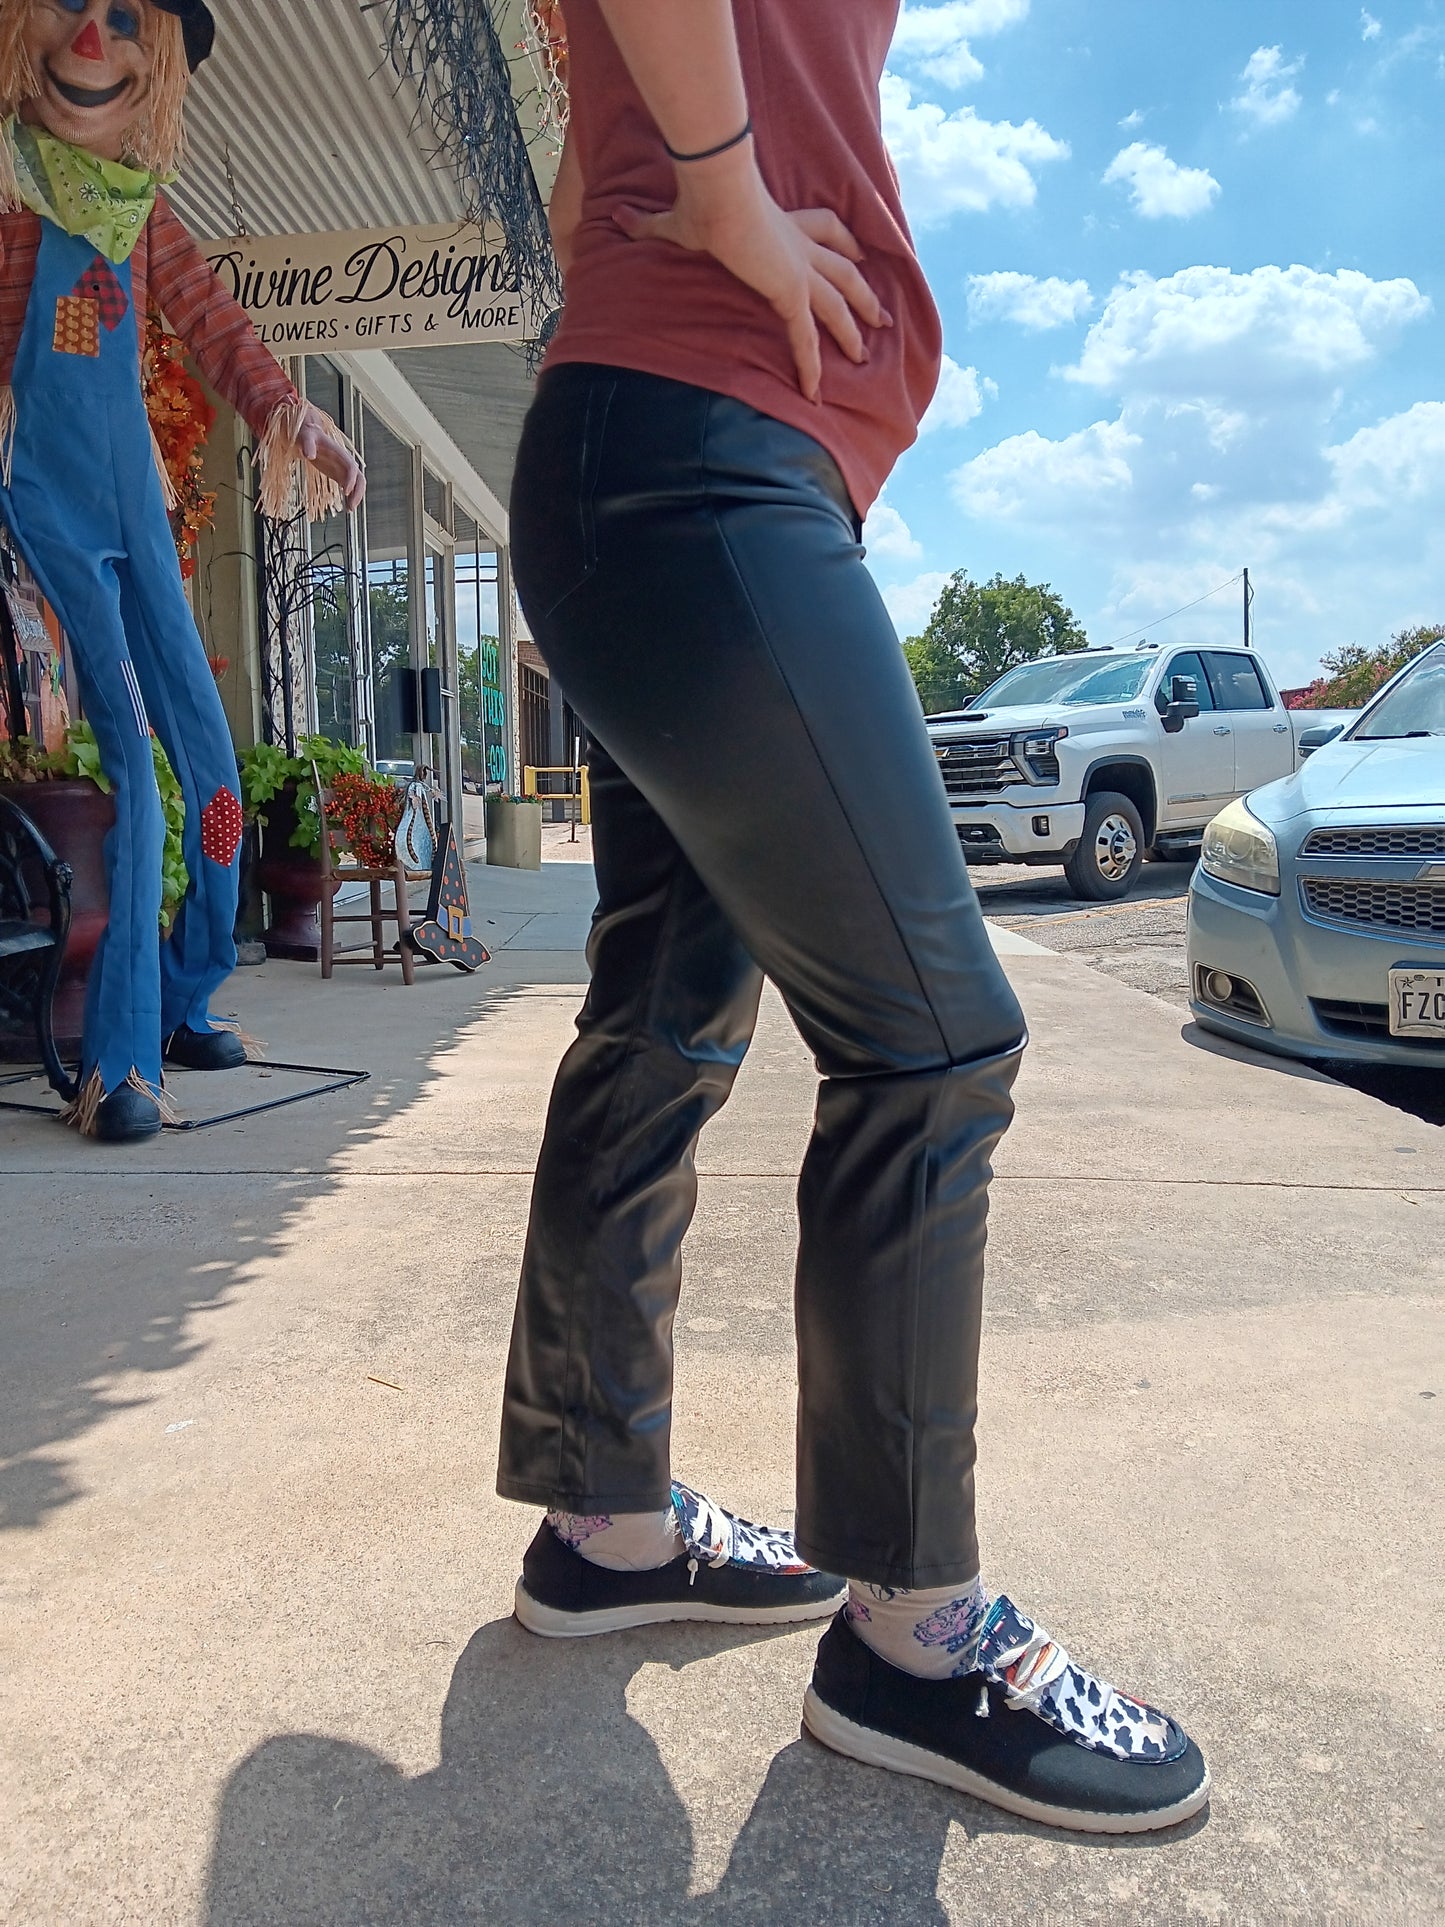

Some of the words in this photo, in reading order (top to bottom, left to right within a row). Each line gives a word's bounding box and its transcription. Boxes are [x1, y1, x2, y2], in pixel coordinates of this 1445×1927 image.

[355, 314, 412, 336] GIFTS
[424, 313, 439, 331] &
[461, 306, 520, 329] MORE
[482, 686, 504, 727] THIS
